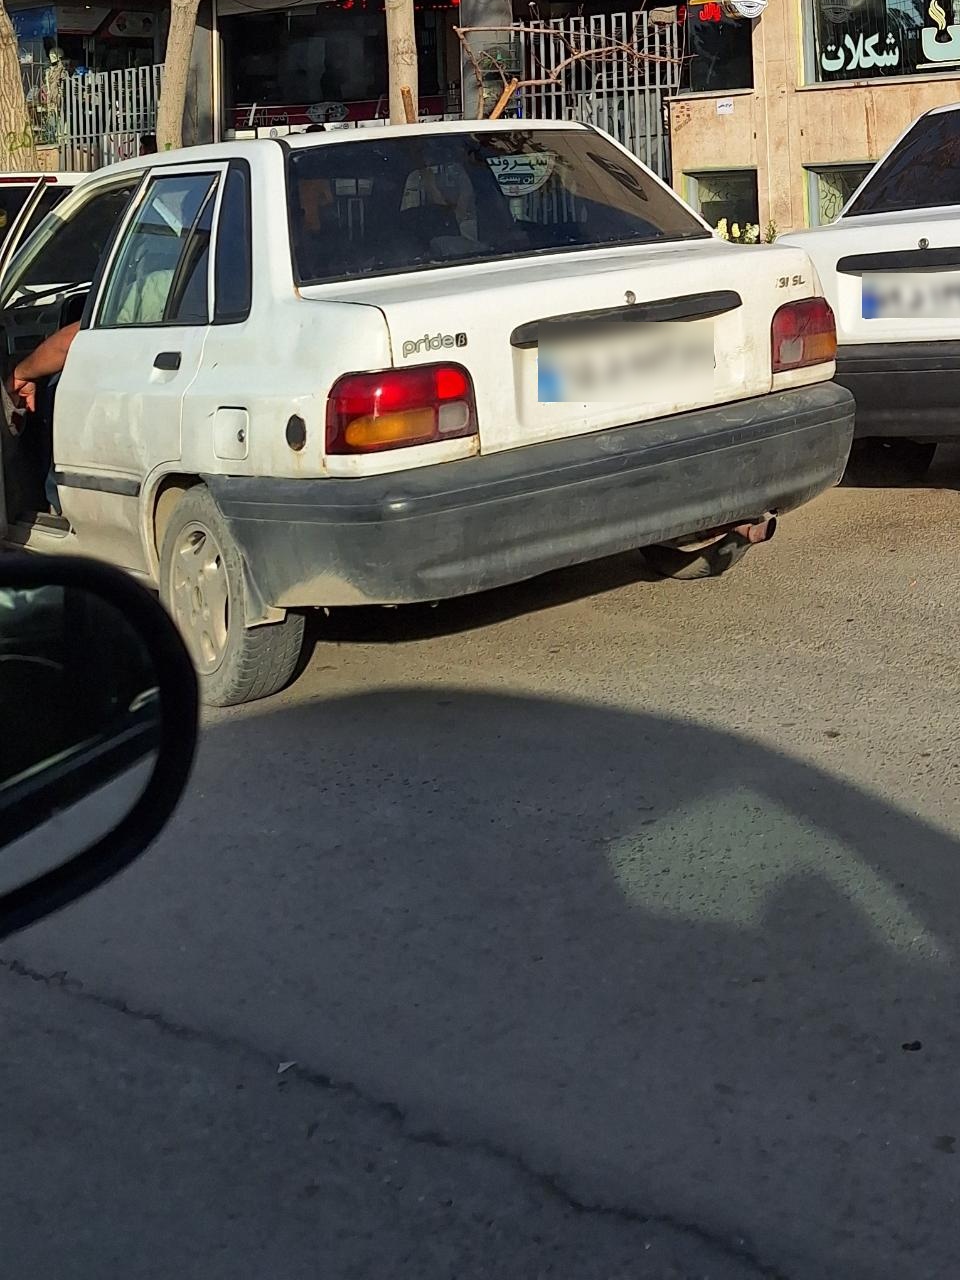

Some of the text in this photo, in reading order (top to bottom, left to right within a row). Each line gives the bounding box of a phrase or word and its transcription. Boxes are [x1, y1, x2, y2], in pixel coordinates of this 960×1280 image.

[821, 31, 900, 73] شکلات
[792, 274, 806, 286] SL
[402, 332, 455, 359] pride
